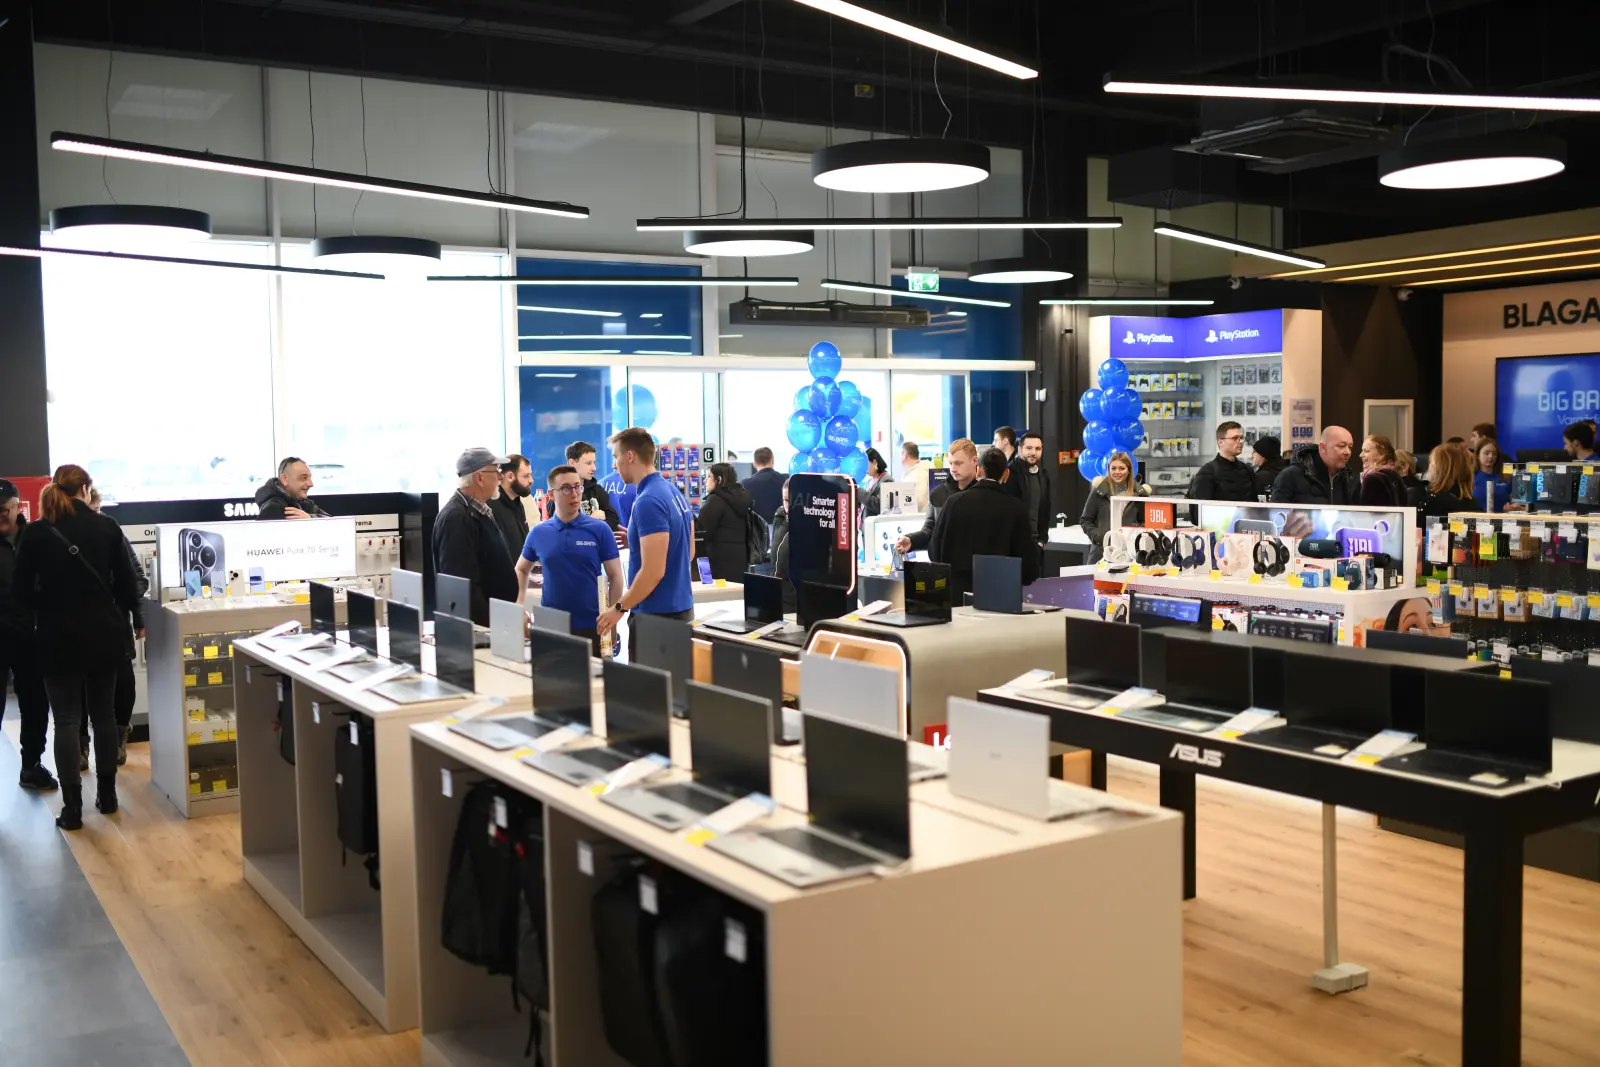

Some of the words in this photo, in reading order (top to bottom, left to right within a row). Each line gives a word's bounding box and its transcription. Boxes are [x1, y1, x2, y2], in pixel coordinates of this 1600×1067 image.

[1503, 297, 1600, 329] BLAGA
[1136, 333, 1174, 345] PlayStation
[1220, 329, 1260, 342] PlayStation
[1538, 391, 1569, 411] BIG
[812, 496, 835, 506] Smarter
[803, 506, 835, 518] technology
[1150, 509, 1167, 523] JBL
[820, 518, 828, 527] for
[246, 547, 284, 557] HUAWEI
[1169, 743, 1223, 768] ASUS
